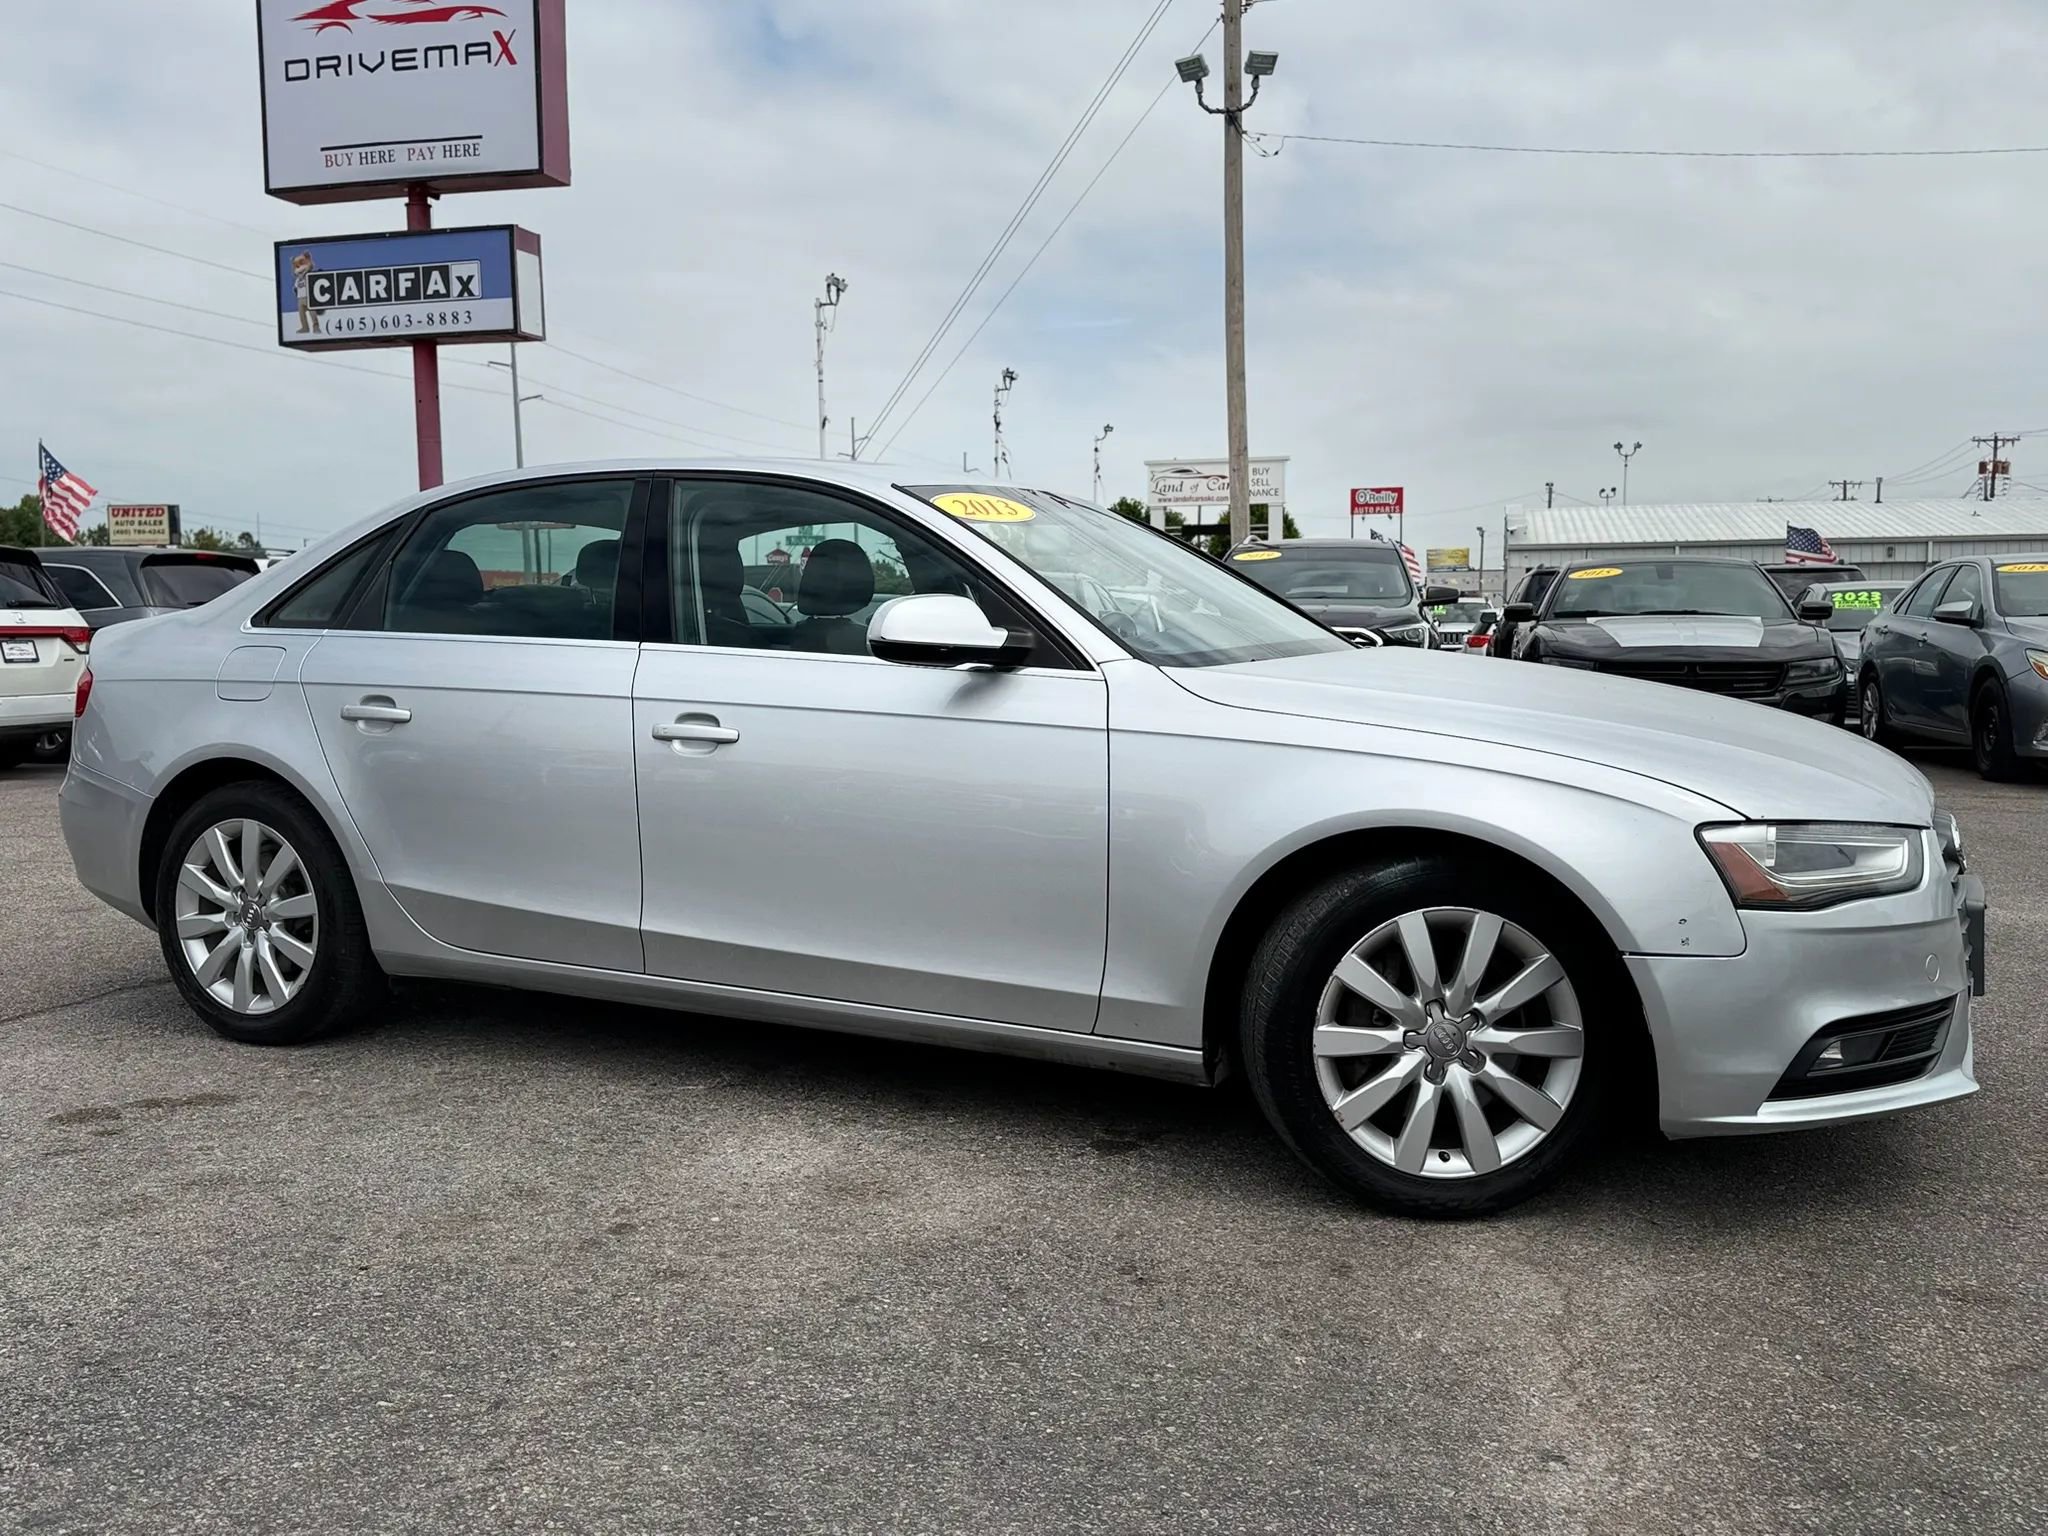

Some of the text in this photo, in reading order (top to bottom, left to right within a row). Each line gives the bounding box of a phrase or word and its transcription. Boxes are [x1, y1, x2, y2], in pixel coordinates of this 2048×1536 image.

[324, 143, 481, 168] BUY HERE PAY HERE
[312, 270, 476, 303] CARFAX
[1252, 467, 1271, 475] BUY
[1152, 480, 1184, 496] Land
[1206, 477, 1230, 491] Car
[1251, 478, 1271, 487] SELL
[1249, 488, 1280, 497] NANCE
[1356, 490, 1397, 504] O'Reilly
[111, 507, 165, 518] UNITED
[952, 499, 1018, 516] 2013
[1353, 505, 1401, 514] AUTO PARTS
[1832, 591, 1881, 601] 2023
